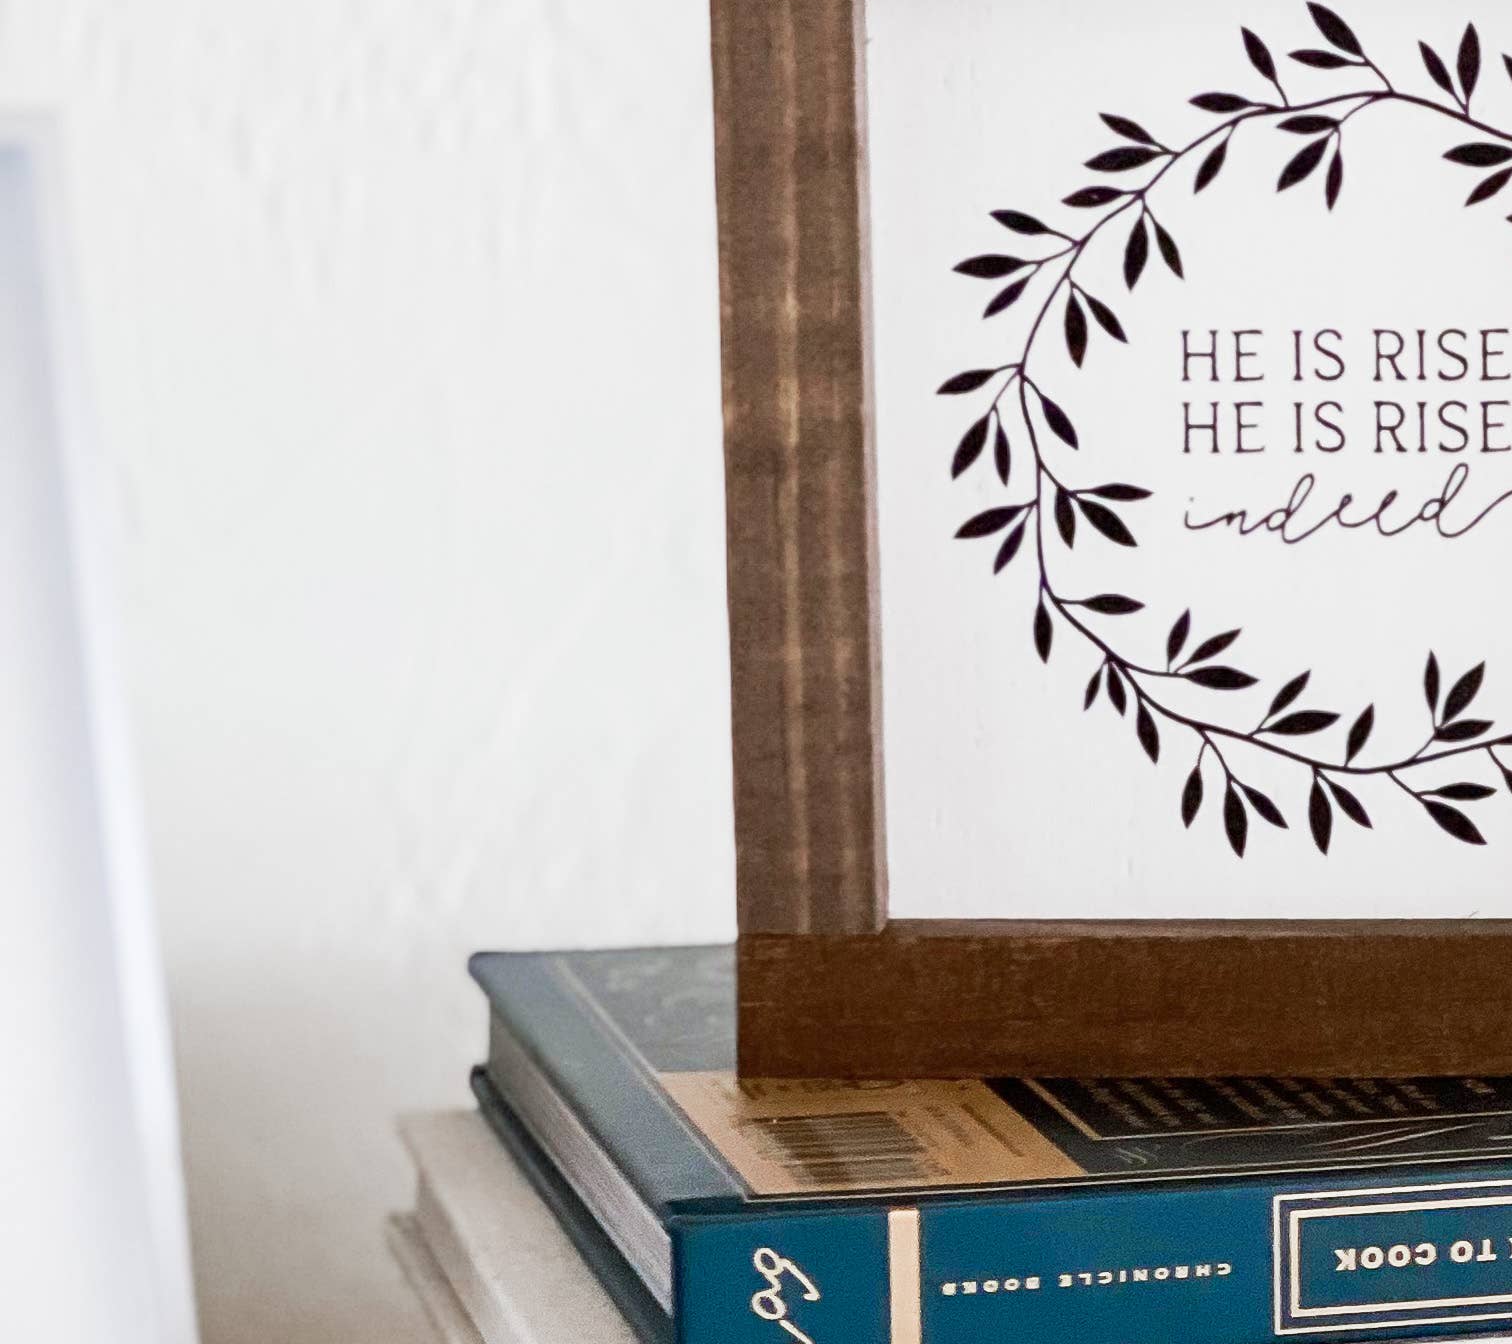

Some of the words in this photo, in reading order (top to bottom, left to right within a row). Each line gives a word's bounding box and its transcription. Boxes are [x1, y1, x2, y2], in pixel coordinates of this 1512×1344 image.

[1182, 329, 1264, 381] HE
[1292, 329, 1345, 381] IS
[1183, 401, 1265, 453] HE
[1293, 401, 1346, 453] IS
[1335, 1242, 1437, 1271] COOK
[1450, 1238, 1496, 1263] TO
[941, 1276, 1041, 1296] BOOKS
[1058, 1263, 1232, 1288] CHRONICLE
